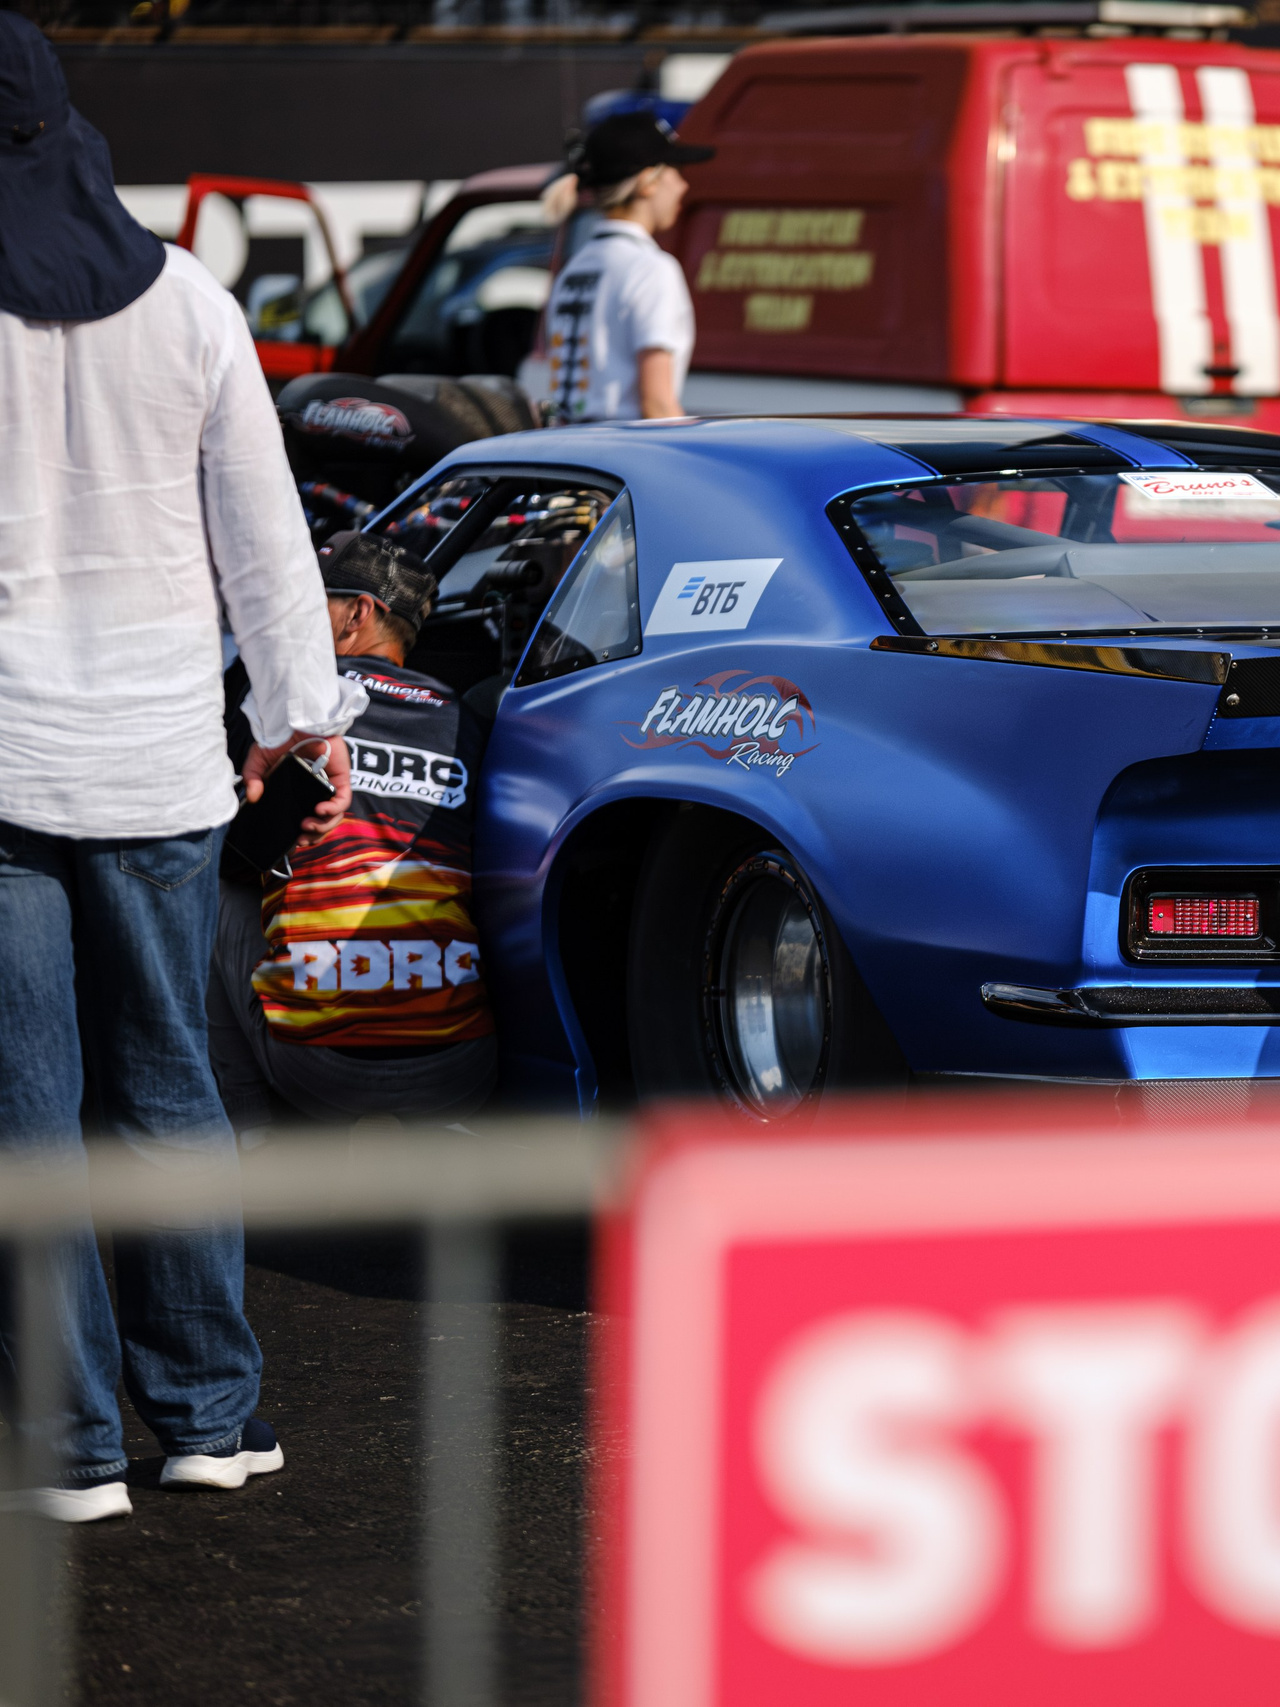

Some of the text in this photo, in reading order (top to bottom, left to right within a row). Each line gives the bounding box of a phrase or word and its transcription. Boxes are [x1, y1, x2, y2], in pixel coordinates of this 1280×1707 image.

[1143, 479, 1256, 495] Bruno's
[691, 581, 747, 616] ВТБ
[639, 684, 800, 741] FLAMHOLC
[346, 741, 464, 788] DRC
[726, 742, 797, 778] Racing
[349, 773, 461, 804] CHNOLOGY
[287, 938, 481, 991] RDRC
